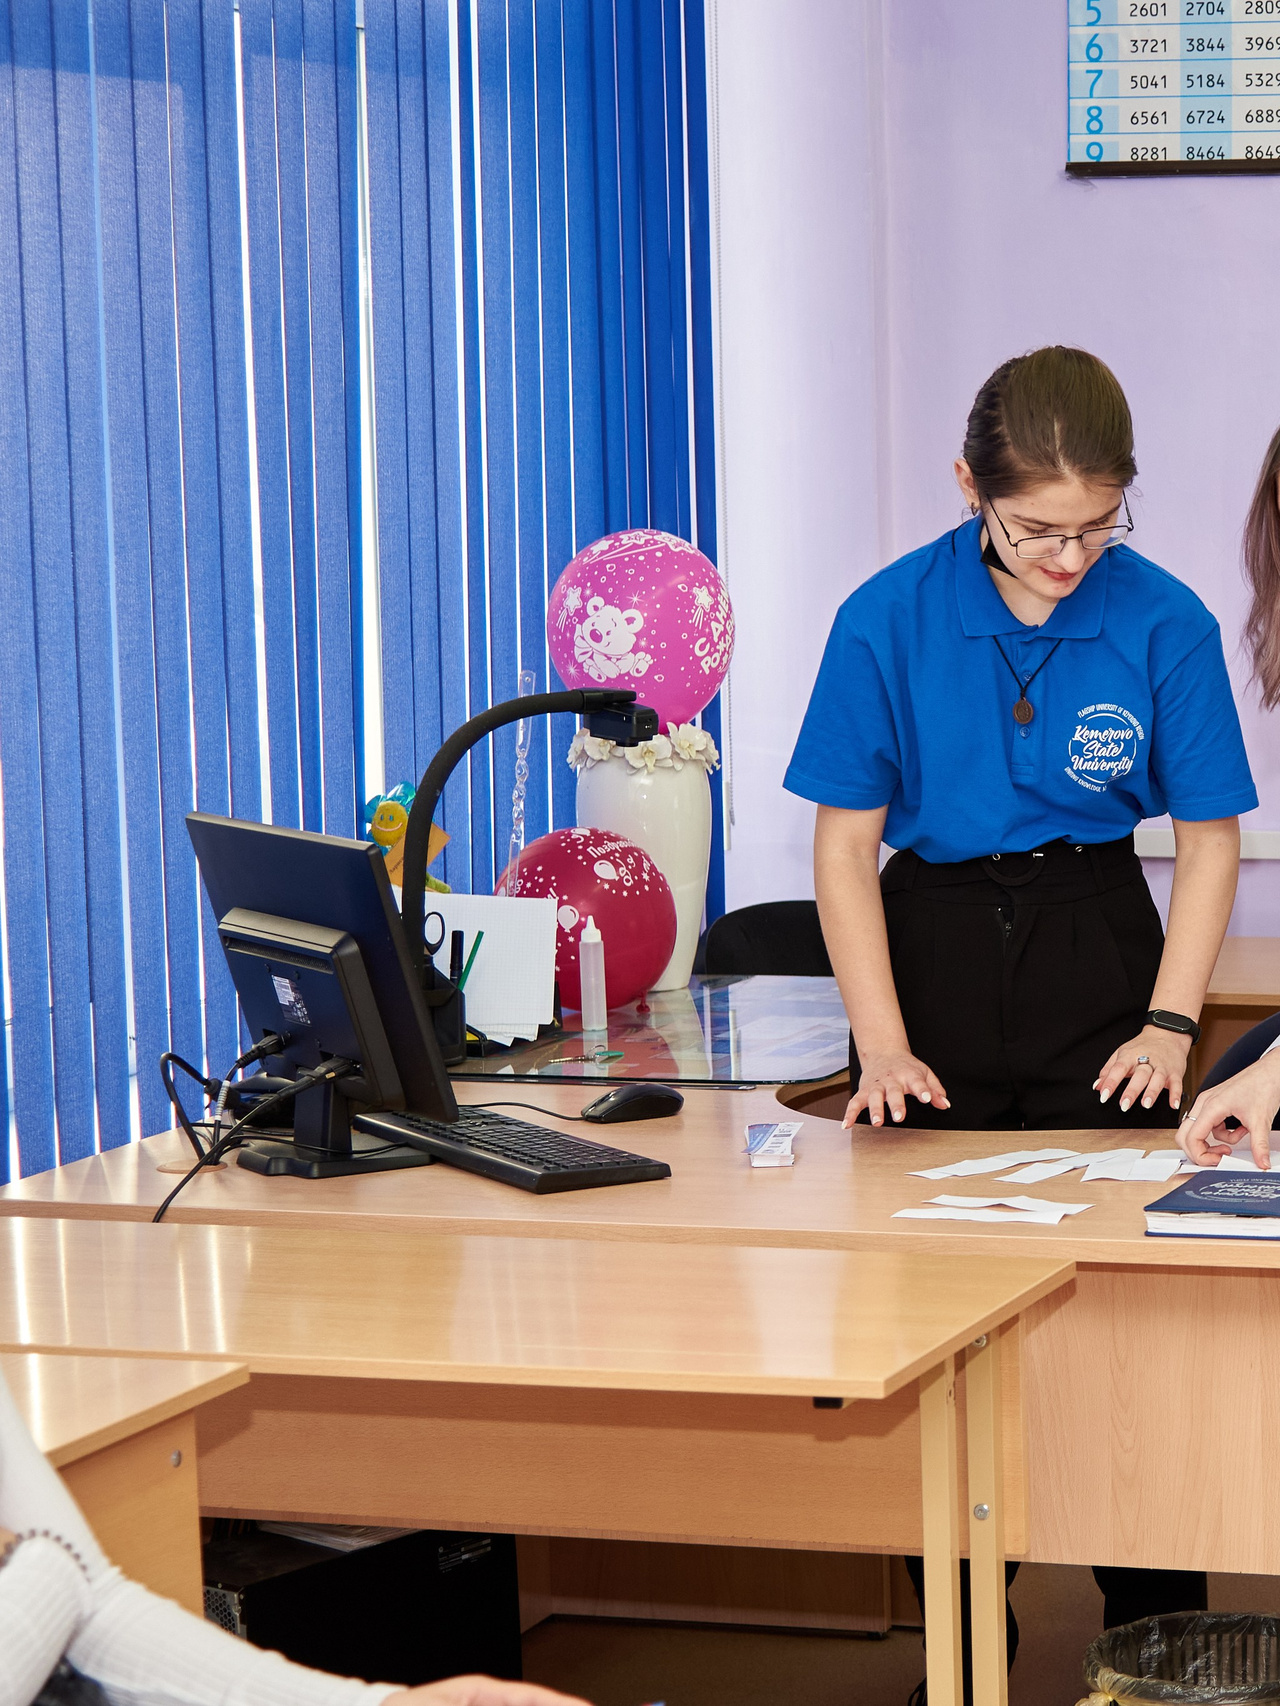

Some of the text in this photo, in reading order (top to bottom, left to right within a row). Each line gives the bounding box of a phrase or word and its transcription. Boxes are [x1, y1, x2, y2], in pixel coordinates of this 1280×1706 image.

[1086, 0, 1102, 26] 5
[1130, 3, 1166, 17] 2601
[1187, 2, 1224, 15] 2704
[1085, 33, 1104, 62] 6
[1131, 39, 1166, 53] 3721
[1187, 38, 1224, 52] 3844
[1085, 70, 1103, 98] 7
[1131, 75, 1166, 89] 5041
[1187, 74, 1224, 88] 5184
[1086, 106, 1104, 134] 8
[1131, 111, 1166, 125] 6561
[1187, 110, 1225, 124] 6724
[1086, 142, 1104, 162] 9
[1130, 147, 1166, 160] 8281
[1186, 146, 1224, 159] 8464
[694, 637, 710, 657] С
[1072, 725, 1134, 743] Kemerovo
[1083, 740, 1124, 759] State
[1071, 755, 1133, 777] University
